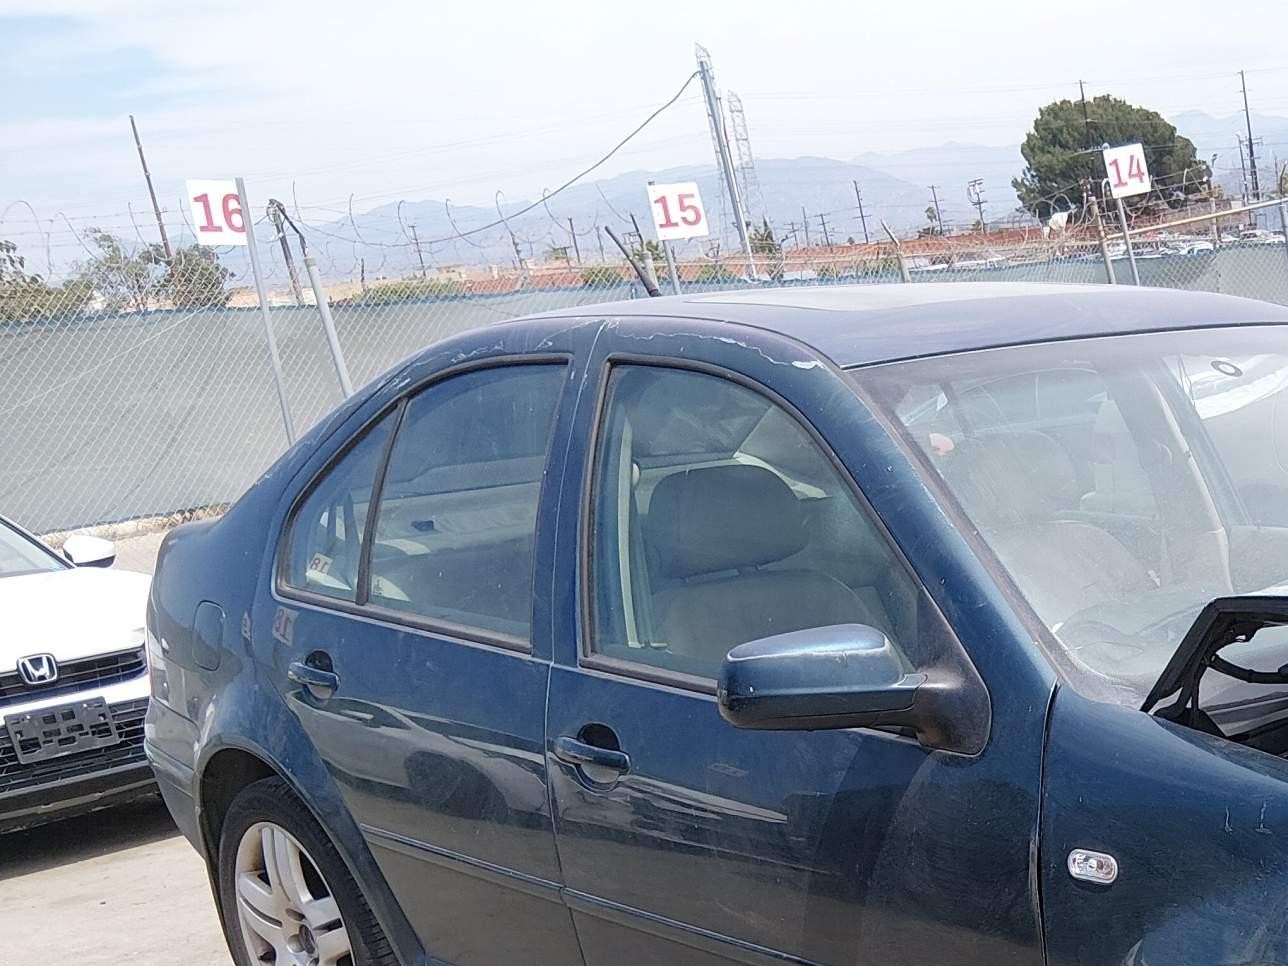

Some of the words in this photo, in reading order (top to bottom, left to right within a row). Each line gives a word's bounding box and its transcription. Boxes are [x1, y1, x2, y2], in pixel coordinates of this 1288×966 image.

[1109, 154, 1145, 188] 14
[193, 193, 246, 233] 16
[653, 193, 702, 229] 15
